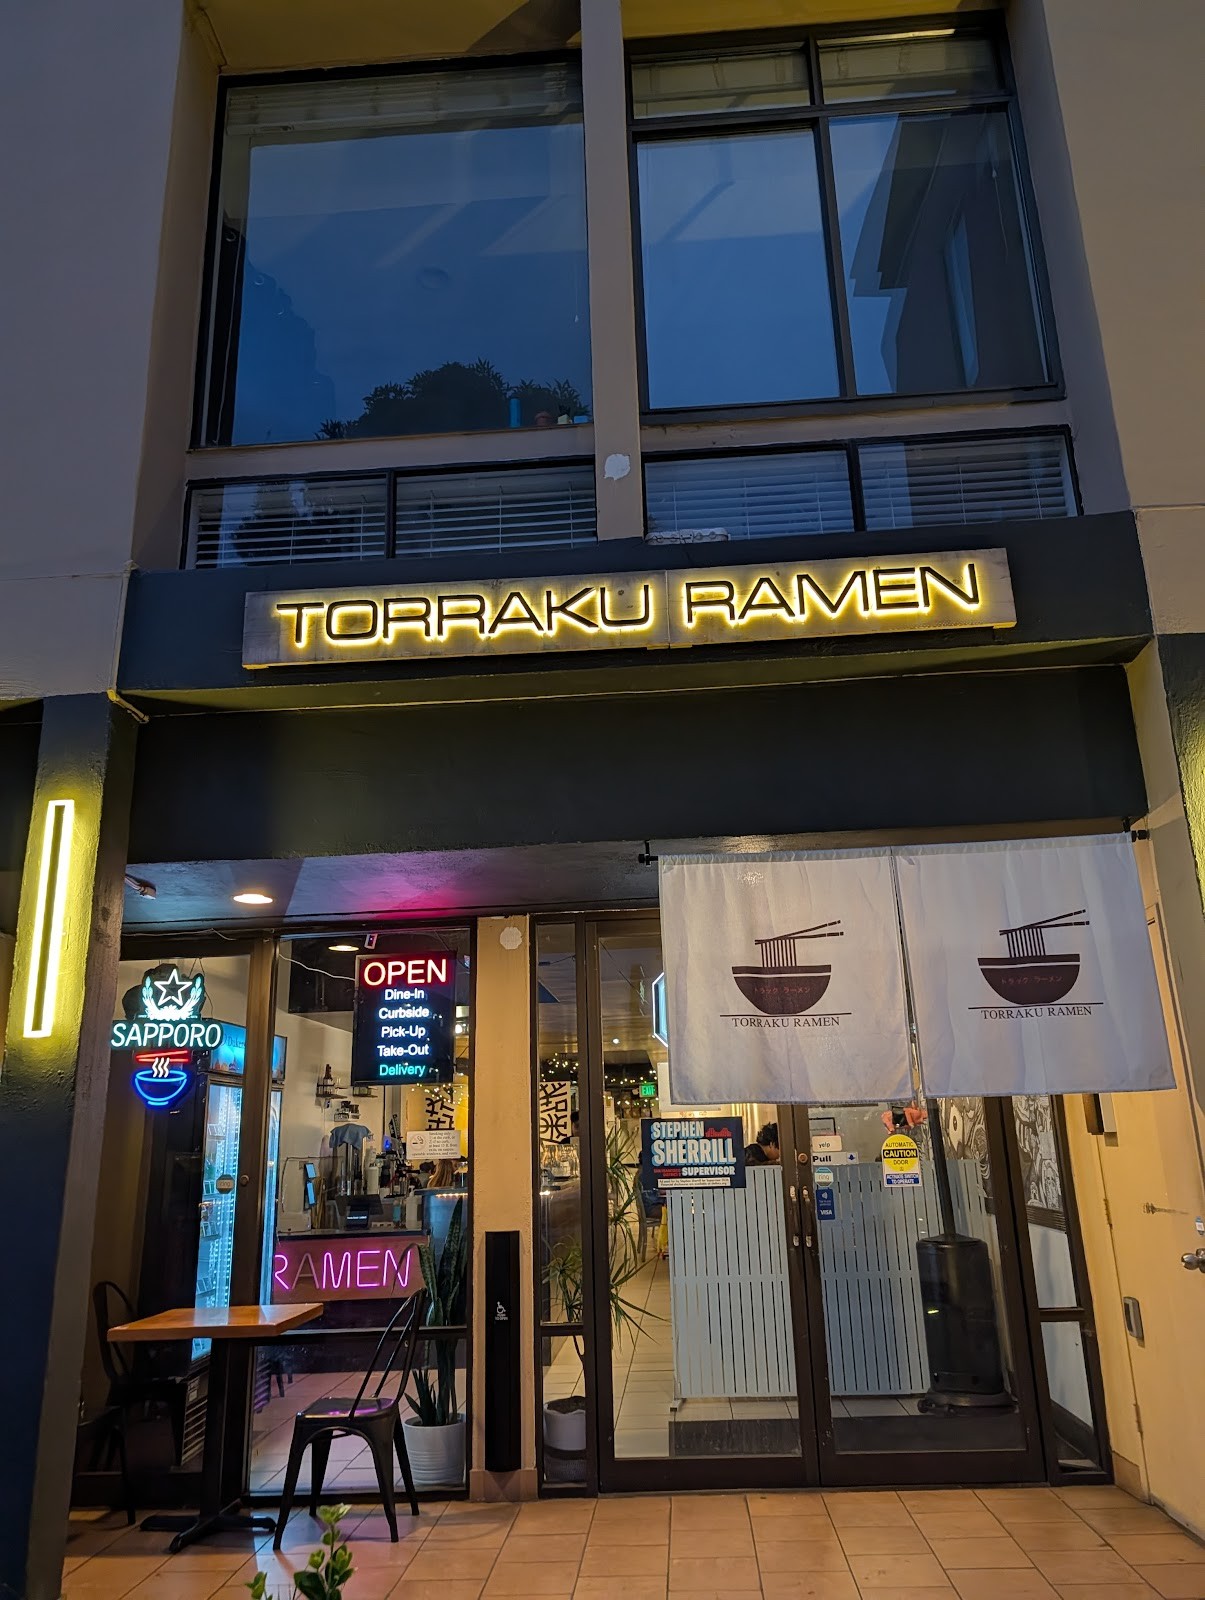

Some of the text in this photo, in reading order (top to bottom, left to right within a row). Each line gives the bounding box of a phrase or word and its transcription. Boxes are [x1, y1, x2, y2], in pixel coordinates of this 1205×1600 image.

[276, 563, 980, 645] TORRAKU RAMEN
[363, 958, 447, 986] OPEN
[384, 988, 425, 1001] Dine-In
[378, 1006, 430, 1019] Curbside
[981, 1006, 1093, 1020] TORRAKU RAMEN
[732, 1016, 840, 1028] TORRAKU RAMEN
[111, 1022, 222, 1048] SAPPORO
[381, 1025, 426, 1039] Pick-Up
[376, 1044, 430, 1057] Take-Out
[379, 1063, 426, 1078] Delivery
[642, 1085, 656, 1096] EXIT
[651, 1121, 704, 1140] STEPHEN
[652, 1138, 737, 1167] SHERRILL
[884, 1150, 917, 1158] CAUTION
[682, 1166, 736, 1176] SUPERVISOR
[274, 1249, 411, 1290] RAMEN
